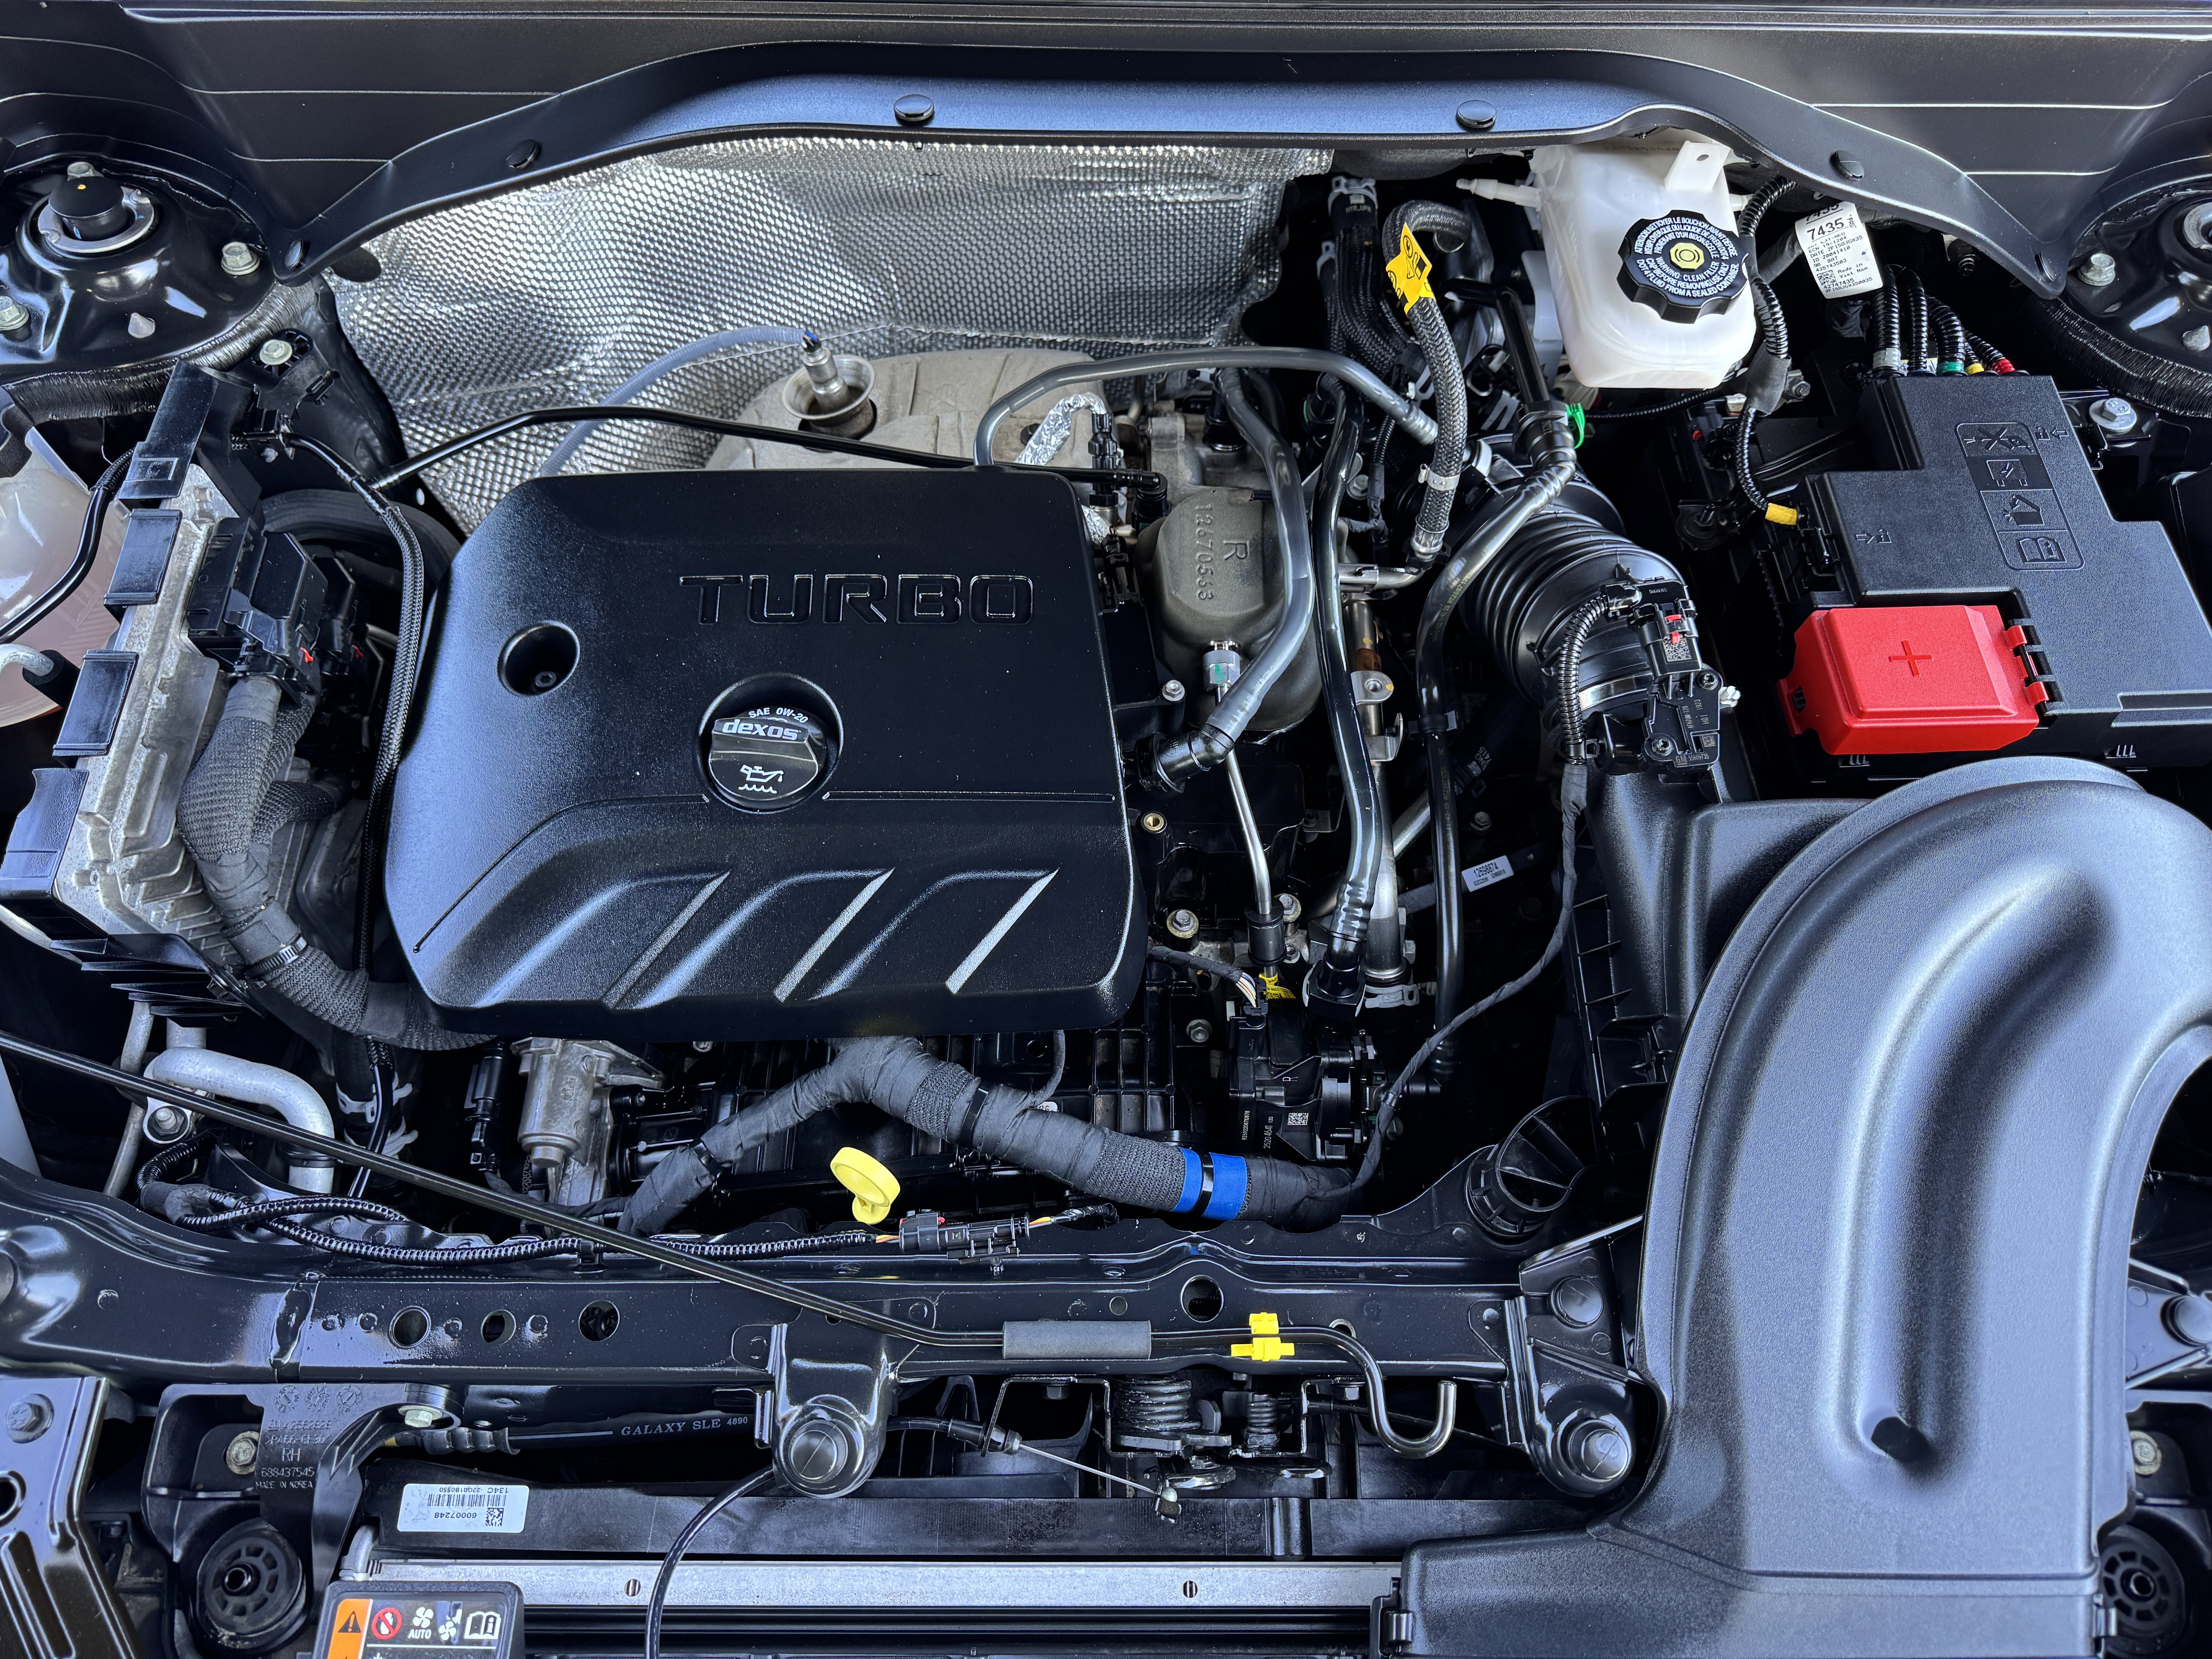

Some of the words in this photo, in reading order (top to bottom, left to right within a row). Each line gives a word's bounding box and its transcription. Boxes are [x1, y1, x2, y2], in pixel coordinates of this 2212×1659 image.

[1660, 225, 1672, 234] QUE
[1680, 224, 1703, 234] LIQUIDE
[1700, 229, 1711, 238] DE
[1707, 234, 1724, 248] FREIN
[1681, 217, 1709, 230] BOUCHON
[1707, 226, 1727, 239] AVANT
[1807, 217, 1844, 240] 7435
[1646, 258, 1657, 272] CAP
[1654, 268, 1677, 286] BEFORE
[1710, 274, 1723, 285] USE
[1718, 262, 1729, 276] ONLY
[1656, 256, 1682, 280] WARNING:
[1683, 273, 1706, 282] CLEAN
[1704, 261, 1719, 278] FILLER
[1837, 266, 1852, 274] Made
[1646, 271, 1666, 288] FLUID
[1664, 285, 1686, 296] FROM
[1692, 287, 1718, 297] SEALED
[1195, 504, 1214, 600] 12670563
[1223, 539, 1250, 561] R
[678, 573, 1034, 625] TURBO
[748, 707, 770, 718] SAE
[776, 707, 809, 723] 0W-20
[722, 719, 799, 740] dexos
[1675, 755, 1688, 765] GM
[621, 1422, 686, 1436] GALAXY
[692, 1419, 721, 1430] SLE
[282, 1448, 301, 1462] RH
[255, 1481, 275, 1489] MADE
[290, 1481, 313, 1489] KOREA
[408, 1629, 432, 1639] AUTO
